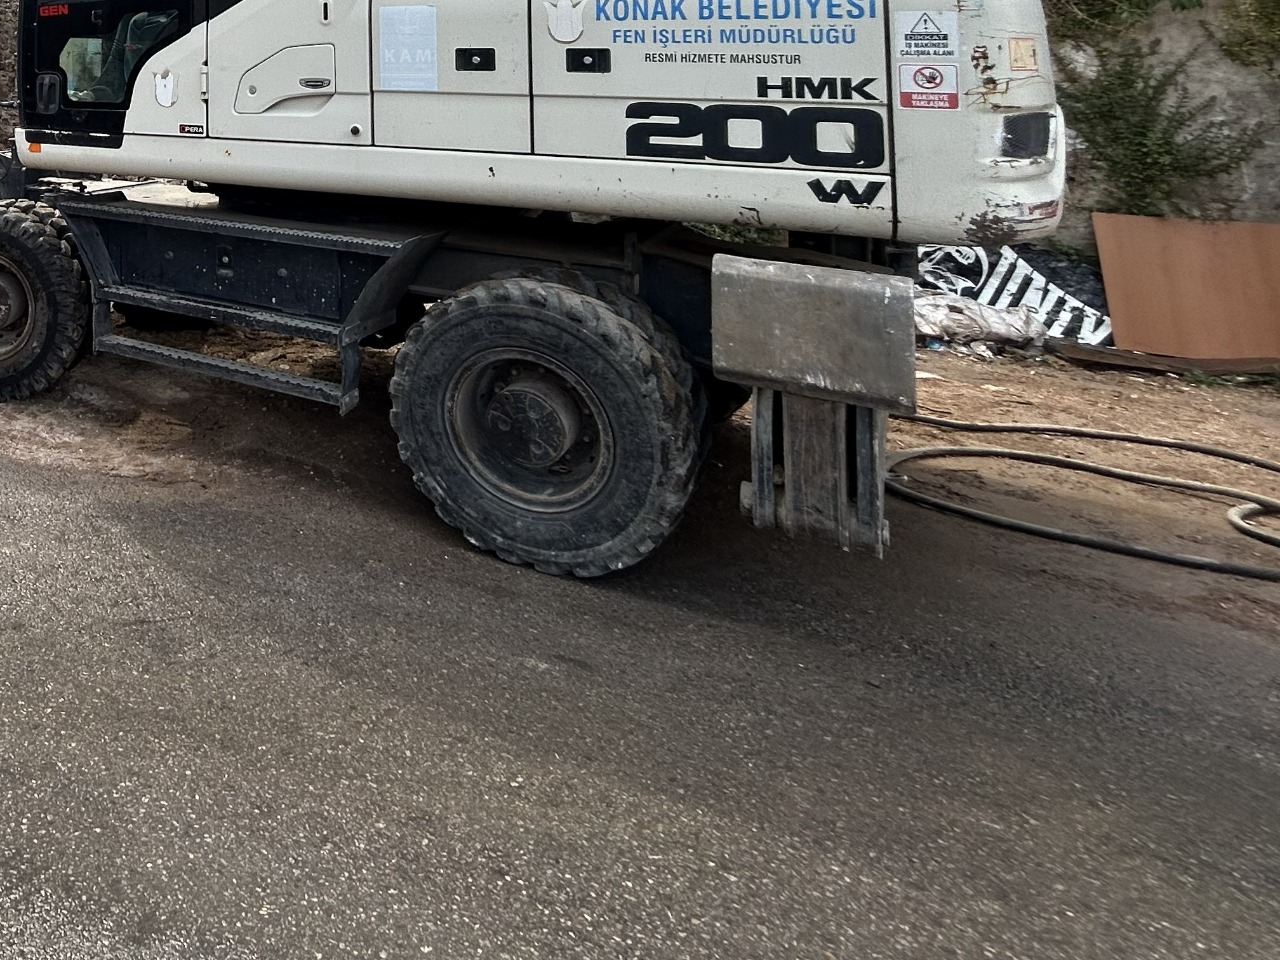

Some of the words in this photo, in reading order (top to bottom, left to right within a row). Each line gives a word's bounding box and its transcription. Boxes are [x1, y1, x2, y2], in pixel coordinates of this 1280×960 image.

[39, 4, 69, 17] GEN
[612, 29, 646, 44] FEN
[652, 25, 713, 49] İŞLERİ
[720, 24, 856, 45] MÜDÜRLÜĞÜ
[644, 51, 678, 63] RESMİ
[680, 51, 727, 64] HİZMETE
[729, 52, 802, 65] MAHSUSTUR
[756, 76, 880, 101] HMK
[625, 101, 886, 169] 200
[806, 177, 887, 206] W
